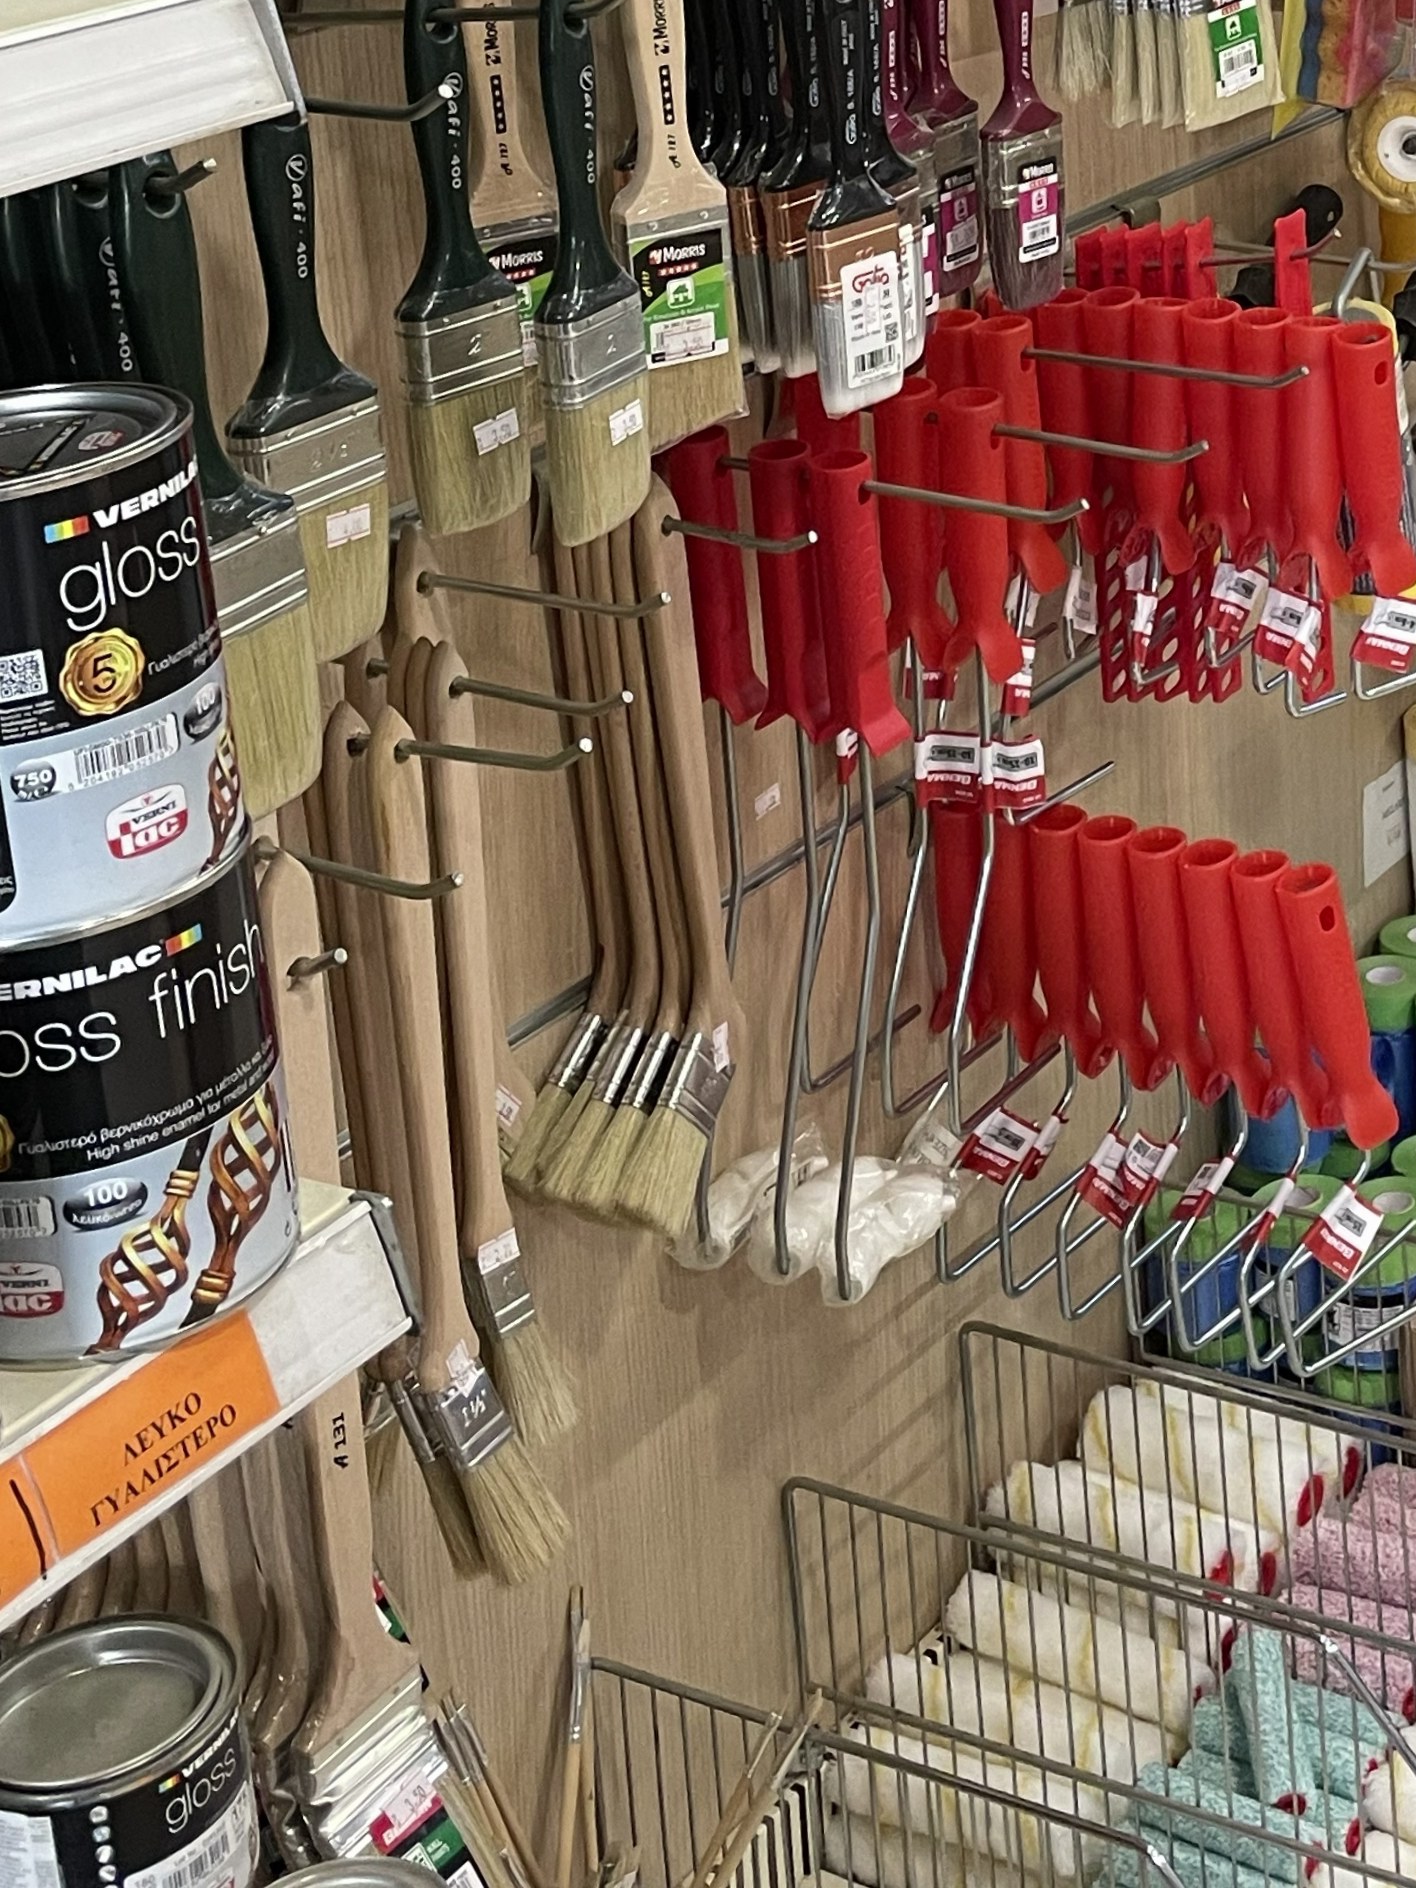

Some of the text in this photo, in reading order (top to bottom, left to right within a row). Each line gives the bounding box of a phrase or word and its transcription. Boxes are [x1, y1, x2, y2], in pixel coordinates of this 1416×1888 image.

[450, 154, 462, 190] 400
[585, 149, 596, 184] 400
[296, 241, 308, 279] 400
[501, 250, 544, 269] MORRIS
[663, 243, 706, 262] MORRIS
[118, 332, 133, 372] 400
[60, 516, 200, 632] gloss
[92, 653, 117, 693] 5
[14, 770, 53, 789] 750
[132, 800, 177, 825] VERNI
[120, 816, 181, 856] lac
[148, 919, 265, 1039] finish
[18, 1130, 97, 1155] Γυαλιστερό
[87, 1142, 121, 1162] High
[123, 1130, 159, 1151] shine
[161, 1109, 206, 1140] enamel
[207, 1100, 222, 1116] for
[84, 1180, 129, 1207] 100
[120, 1392, 202, 1467] ΛΕΥΚΟ
[88, 1403, 237, 1528] ΓΥΑΛΙΣΤΕΡΟ
[165, 1748, 237, 1834] gloss
